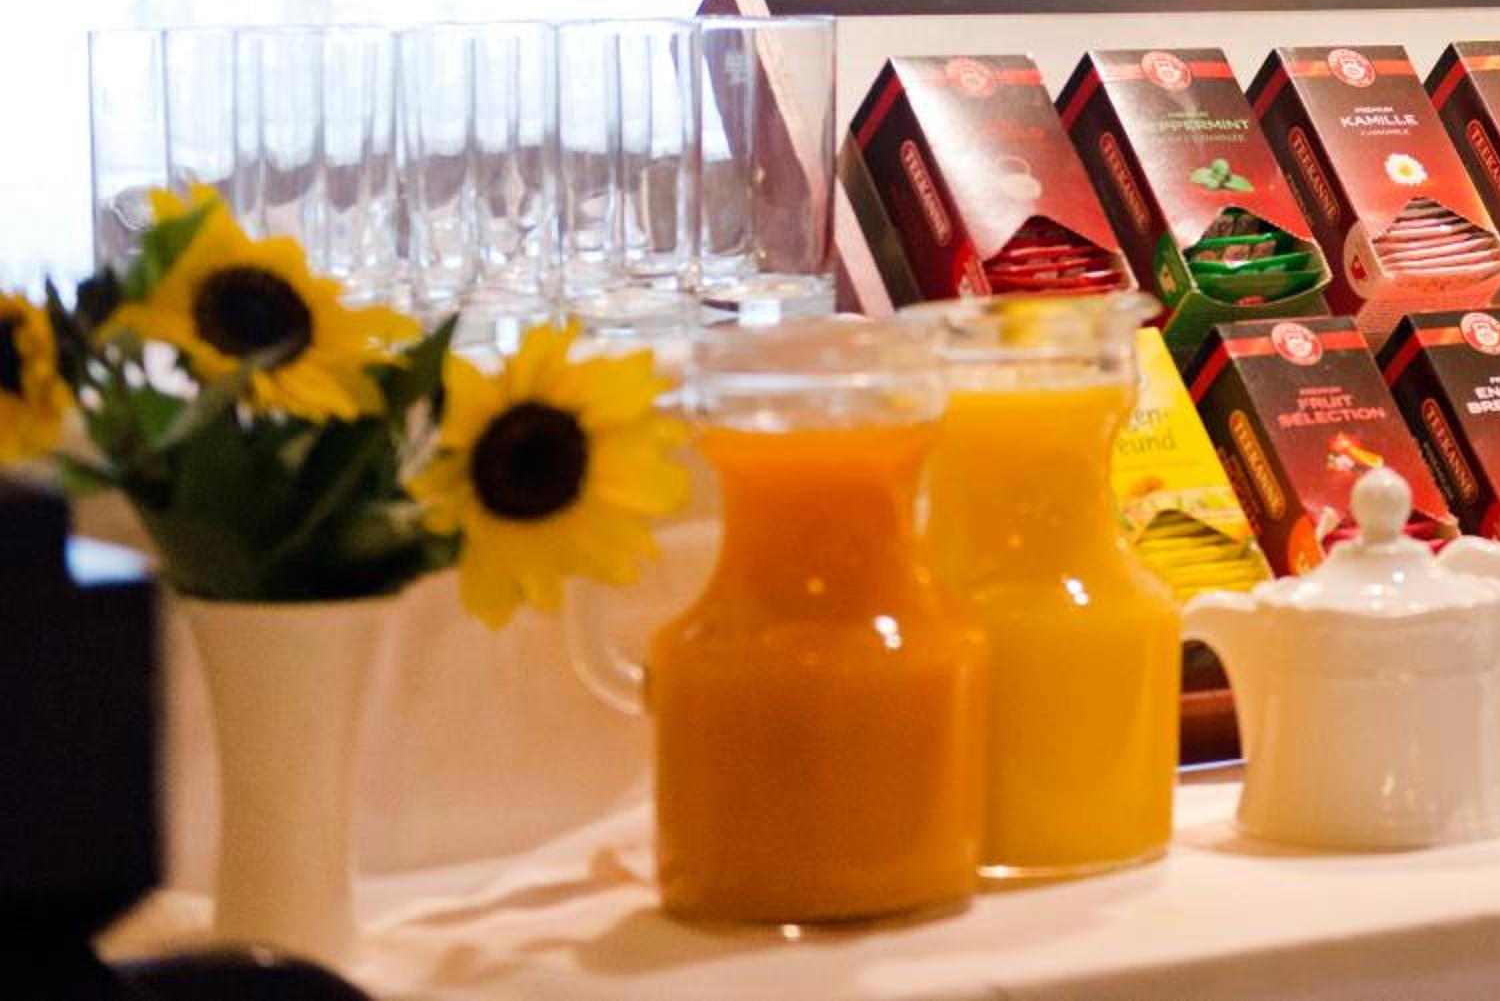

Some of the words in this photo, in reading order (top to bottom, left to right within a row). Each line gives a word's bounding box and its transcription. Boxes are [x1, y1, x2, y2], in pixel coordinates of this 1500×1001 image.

[1340, 114, 1418, 128] KAMILLE
[902, 142, 951, 243] TEEKANNE
[1101, 137, 1148, 231] TEEKANNE
[1290, 131, 1339, 219] TEEKANNE
[1278, 407, 1385, 428] SELECTION
[1297, 394, 1352, 411] FRUIT
[1231, 413, 1285, 519] TEEKANNE
[1424, 402, 1477, 499] TEEKANNE
